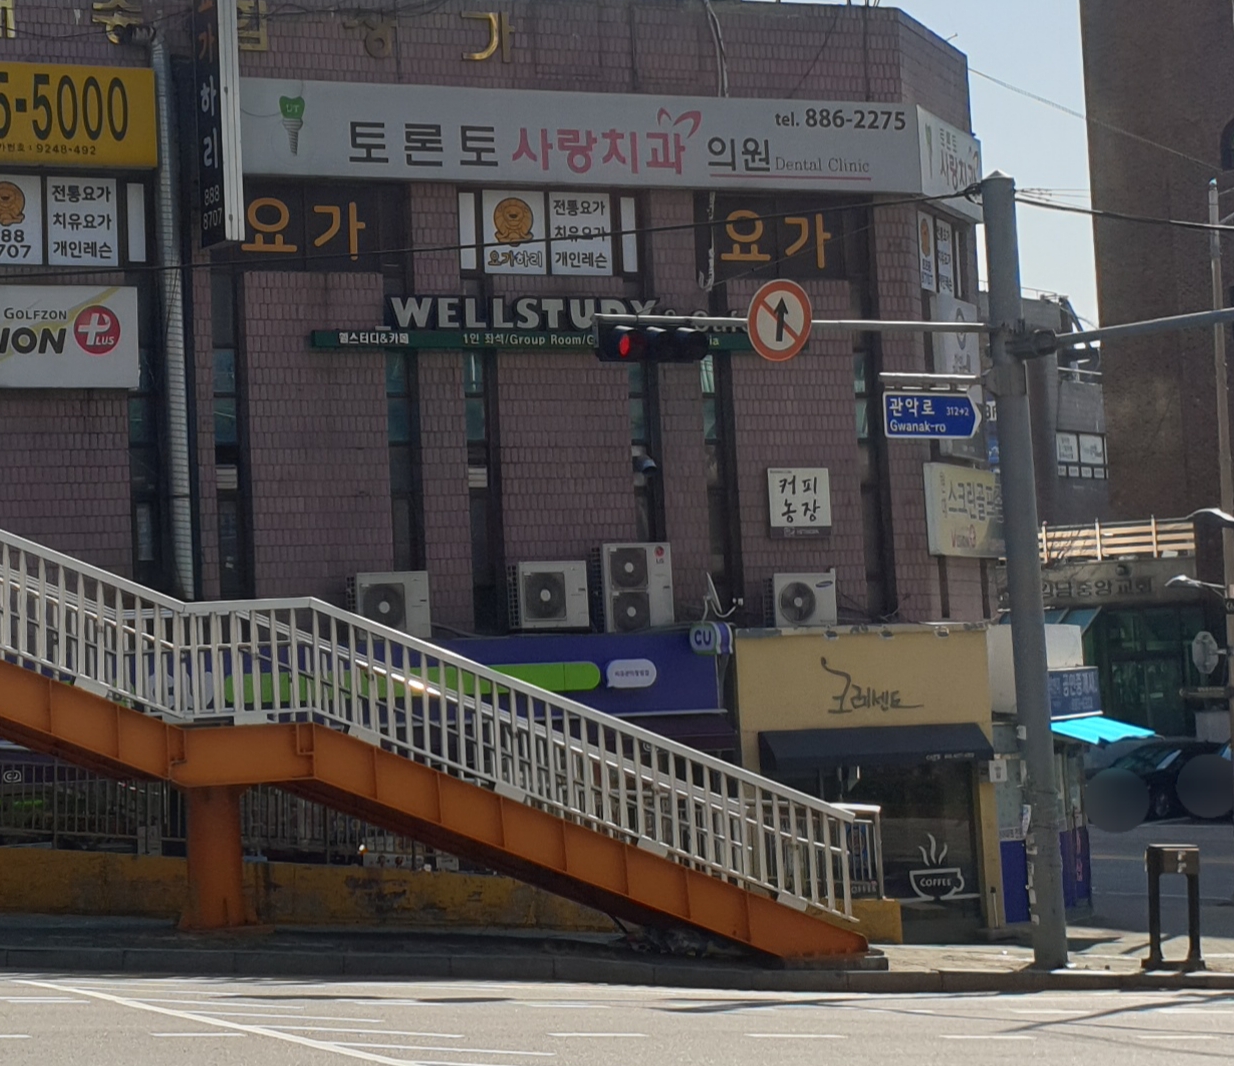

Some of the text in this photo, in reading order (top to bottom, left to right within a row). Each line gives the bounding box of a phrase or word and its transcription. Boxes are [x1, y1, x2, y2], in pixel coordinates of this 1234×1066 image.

[805, 108, 906, 131] 886-2275
[775, 157, 870, 173] Dental Clinic
[51, 184, 111, 203] 전통요가
[553, 199, 606, 217] 전통요가
[52, 212, 112, 231] 치유요가
[240, 197, 366, 261] 요가
[720, 209, 831, 269] 요가
[52, 240, 113, 259] 개인레슨
[487, 250, 543, 268] 요가하리
[555, 251, 608, 269] 개인레슨
[888, 397, 935, 418] 관악로
[889, 419, 946, 433] Gwanak-ro
[779, 475, 817, 495] 커피
[781, 498, 821, 523] 농장
[694, 629, 712, 646] CU
[919, 877, 951, 887] COFFEE
